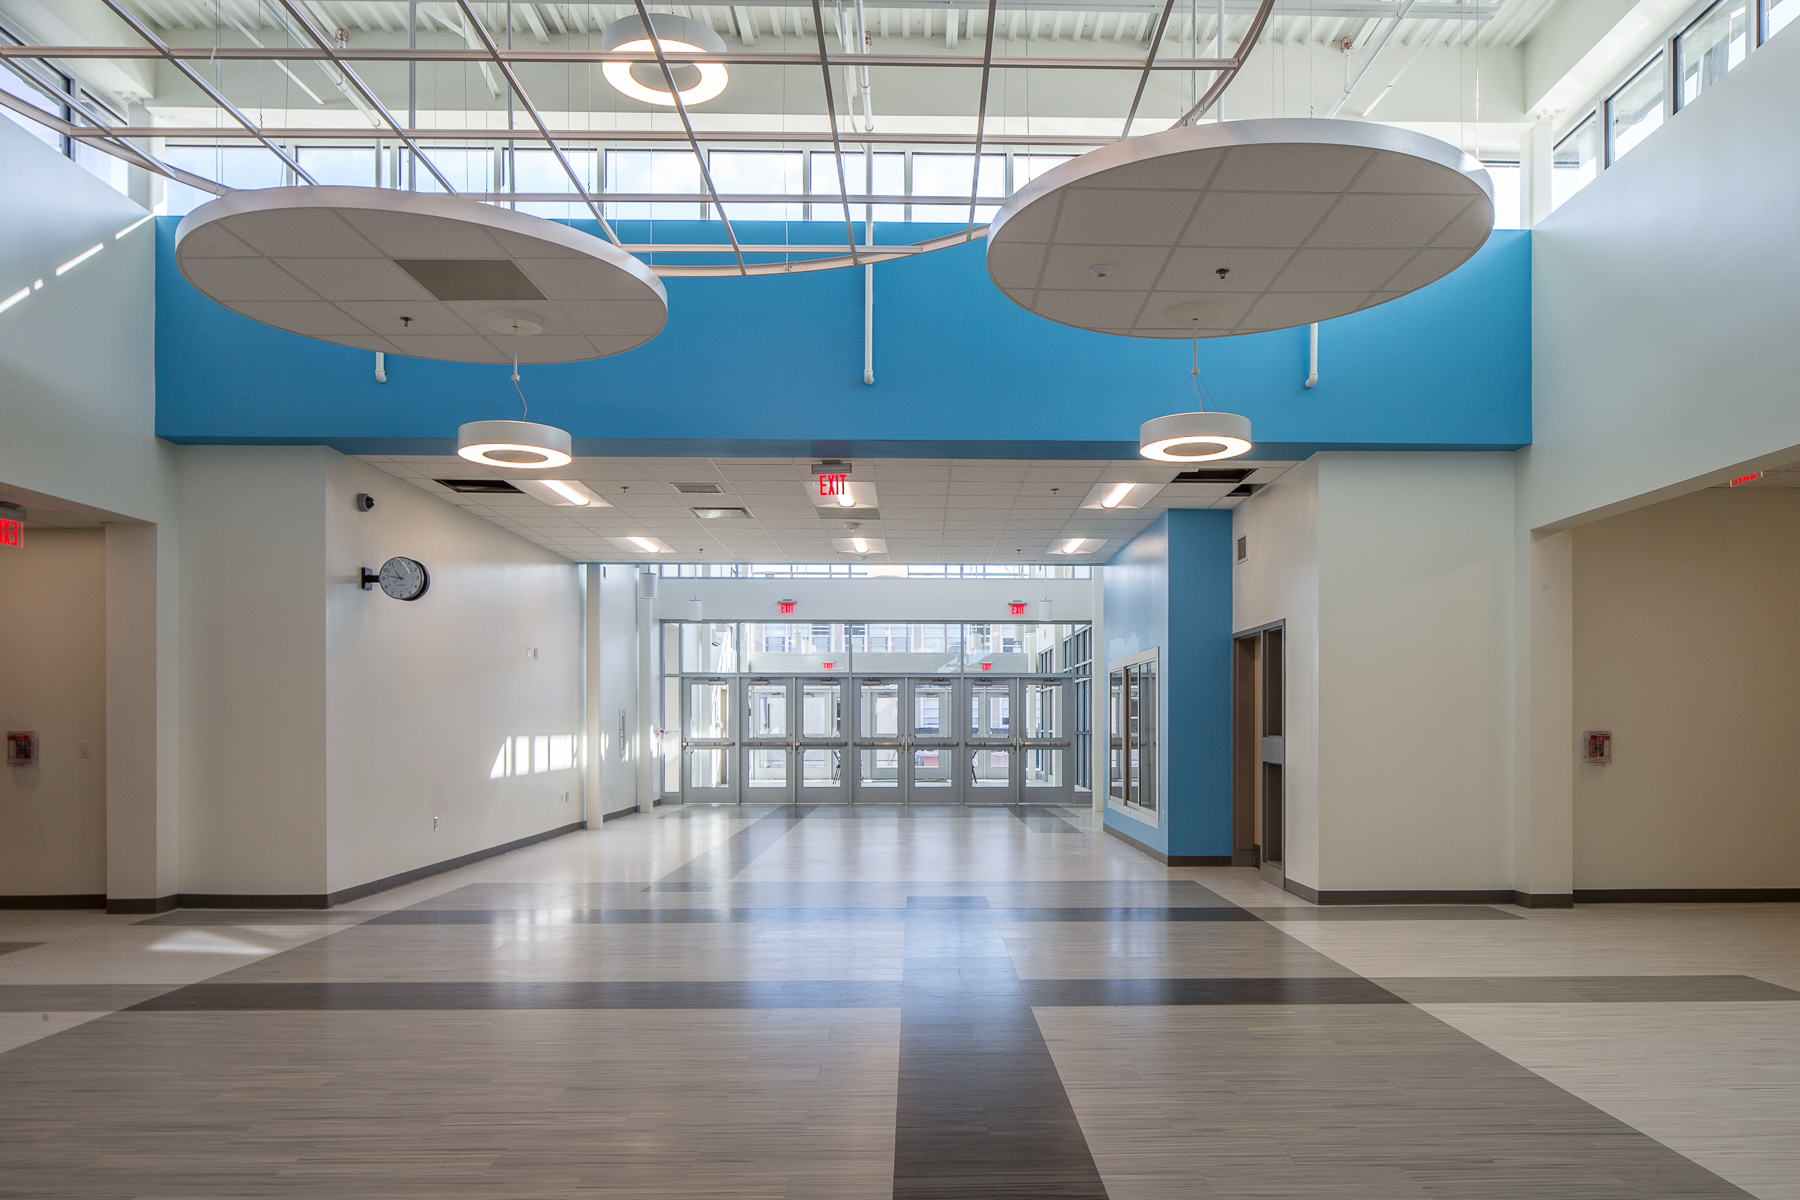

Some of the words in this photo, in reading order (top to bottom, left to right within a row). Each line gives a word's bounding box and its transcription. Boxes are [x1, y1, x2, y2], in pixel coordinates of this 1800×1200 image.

[819, 474, 847, 496] EXIT
[780, 603, 794, 613] EXIT
[1012, 604, 1025, 614] EXIT
